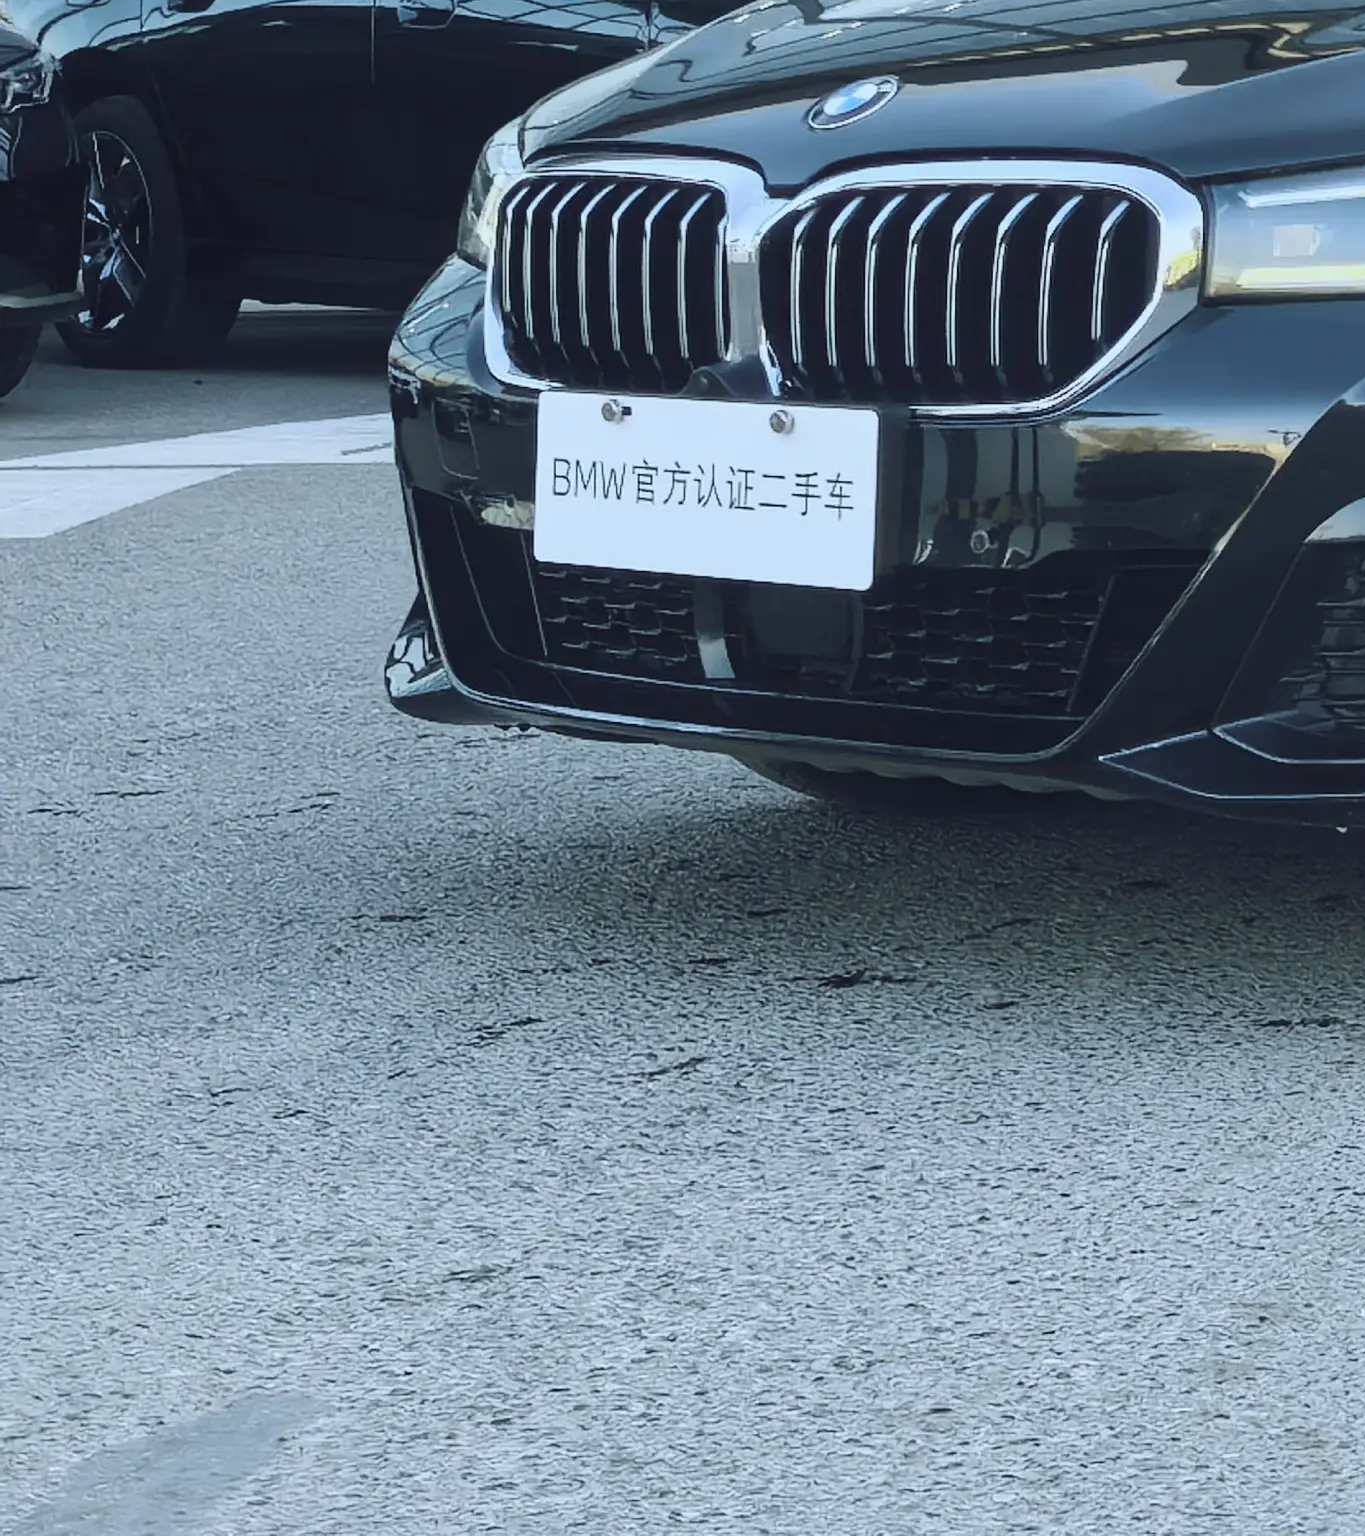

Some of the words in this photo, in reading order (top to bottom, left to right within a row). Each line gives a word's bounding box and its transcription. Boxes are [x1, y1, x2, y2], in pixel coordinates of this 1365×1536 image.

[553, 458, 855, 521] BMW官方认证二手车
